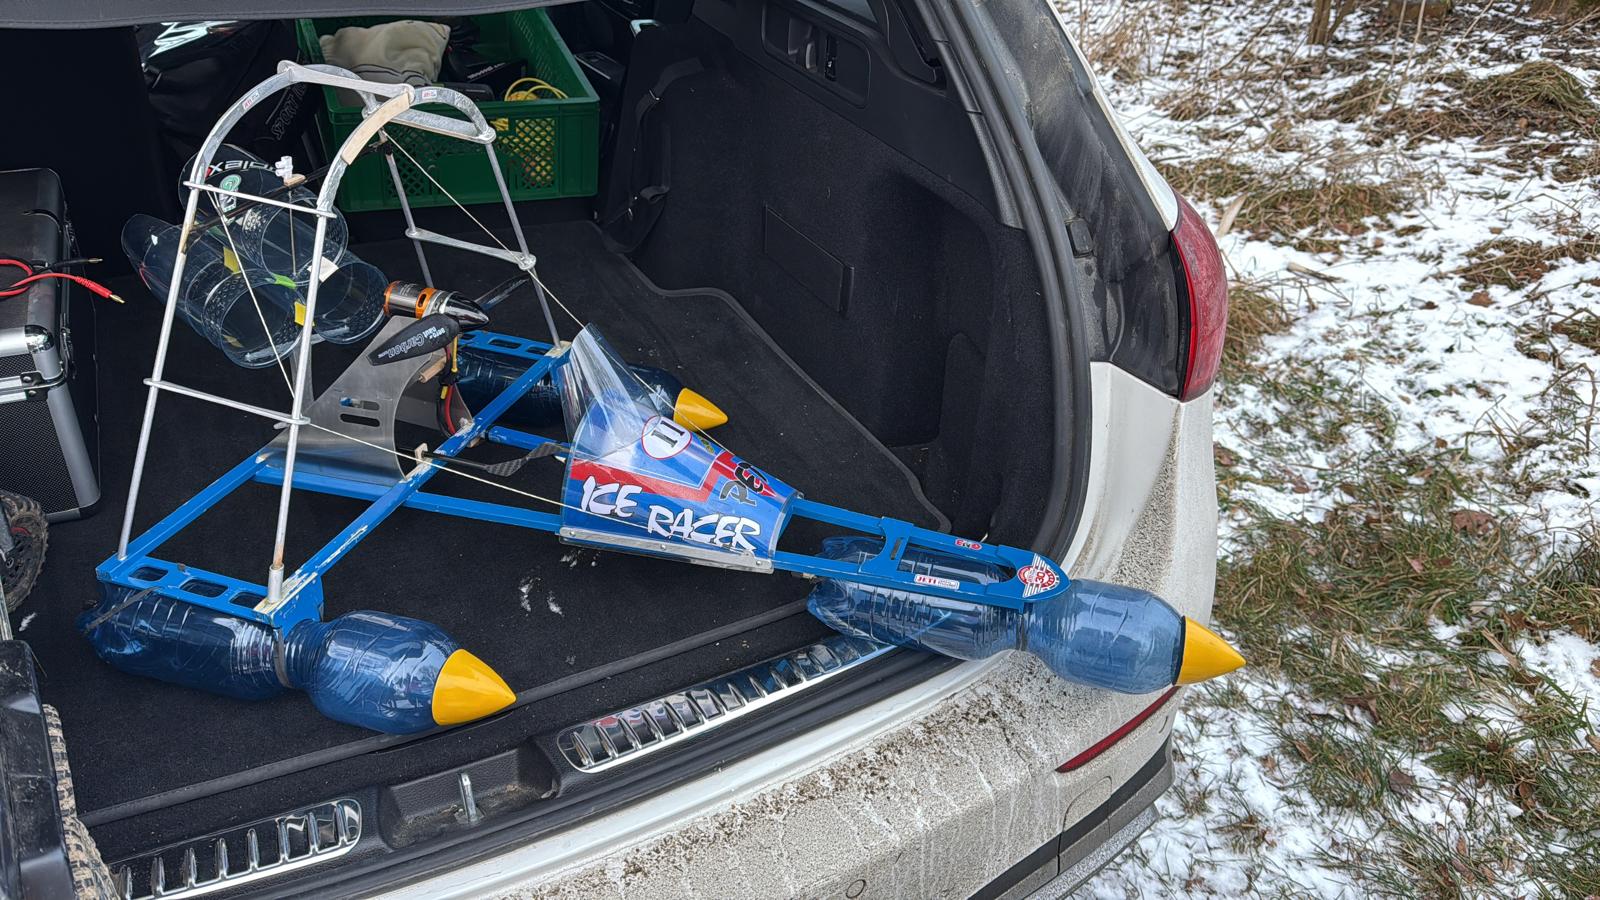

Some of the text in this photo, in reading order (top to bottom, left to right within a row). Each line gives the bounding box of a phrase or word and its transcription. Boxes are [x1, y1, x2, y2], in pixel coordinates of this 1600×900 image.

[388, 333, 425, 358] Carbon
[581, 475, 761, 553] ICE RACER
